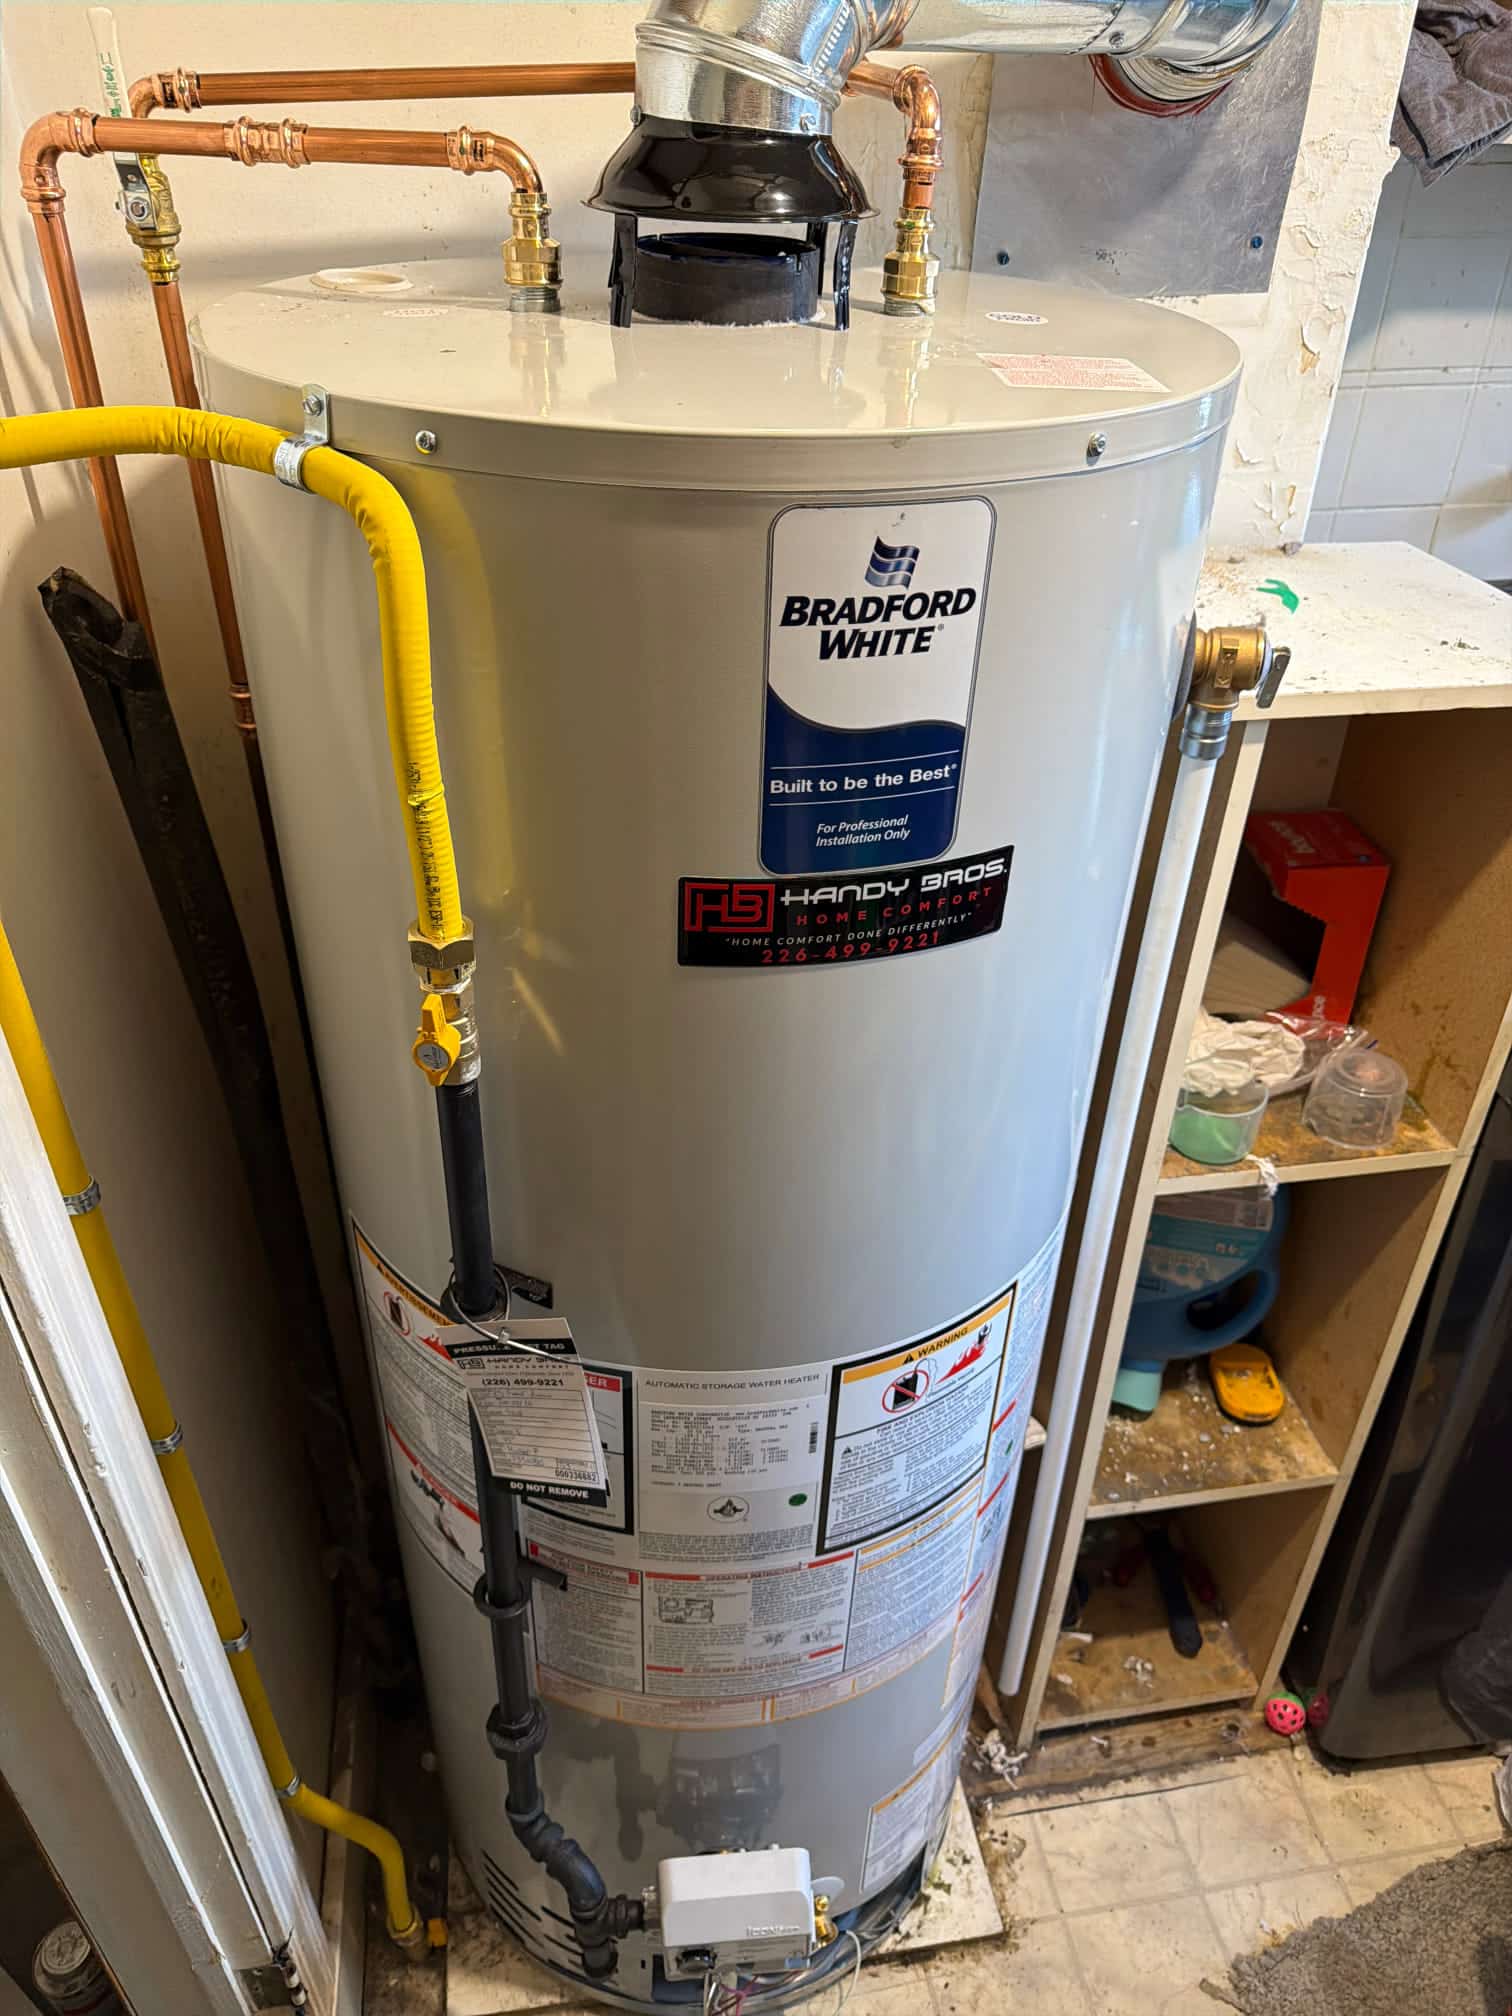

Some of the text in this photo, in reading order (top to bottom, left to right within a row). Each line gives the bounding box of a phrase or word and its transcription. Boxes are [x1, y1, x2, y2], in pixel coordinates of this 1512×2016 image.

[779, 588, 976, 626] BRADFORD
[770, 779, 812, 794] Built
[819, 778, 837, 792] to
[844, 776, 868, 790] be
[875, 773, 903, 787] the
[817, 814, 909, 834] For Professional
[816, 828, 911, 847] Installation Only
[780, 879, 909, 906] HANDY
[796, 886, 993, 926] HOME COMFORT
[762, 931, 941, 963] 226-499-9221
[776, 933, 842, 945] COMFORT
[847, 929, 882, 941] DONE
[917, 1327, 969, 1358] WARNING
[645, 1374, 820, 1390] AUTOMATIC STORAGE WATER HEATER
[510, 1481, 590, 1499] DO NOT REMOVE
